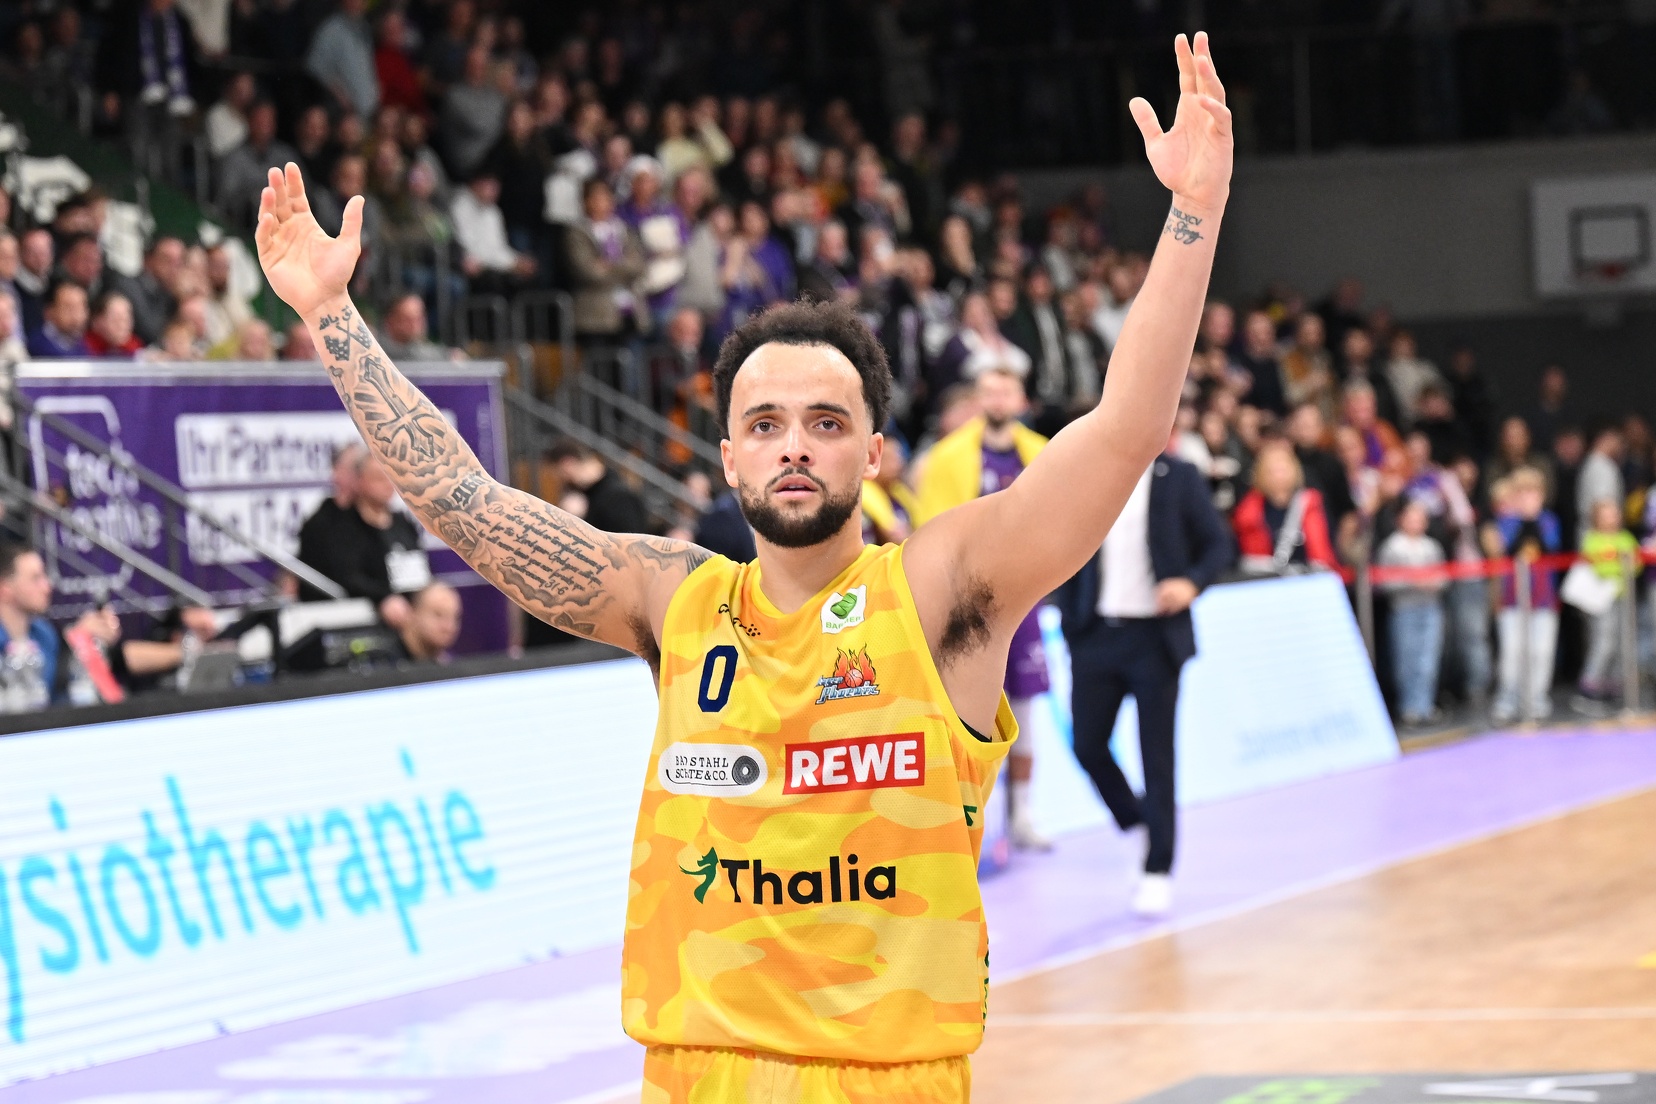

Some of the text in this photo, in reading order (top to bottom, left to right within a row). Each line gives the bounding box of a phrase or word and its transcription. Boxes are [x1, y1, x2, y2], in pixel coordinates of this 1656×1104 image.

[698, 645, 739, 713] 0
[790, 740, 920, 789] REWE
[720, 853, 896, 905] Thalia
